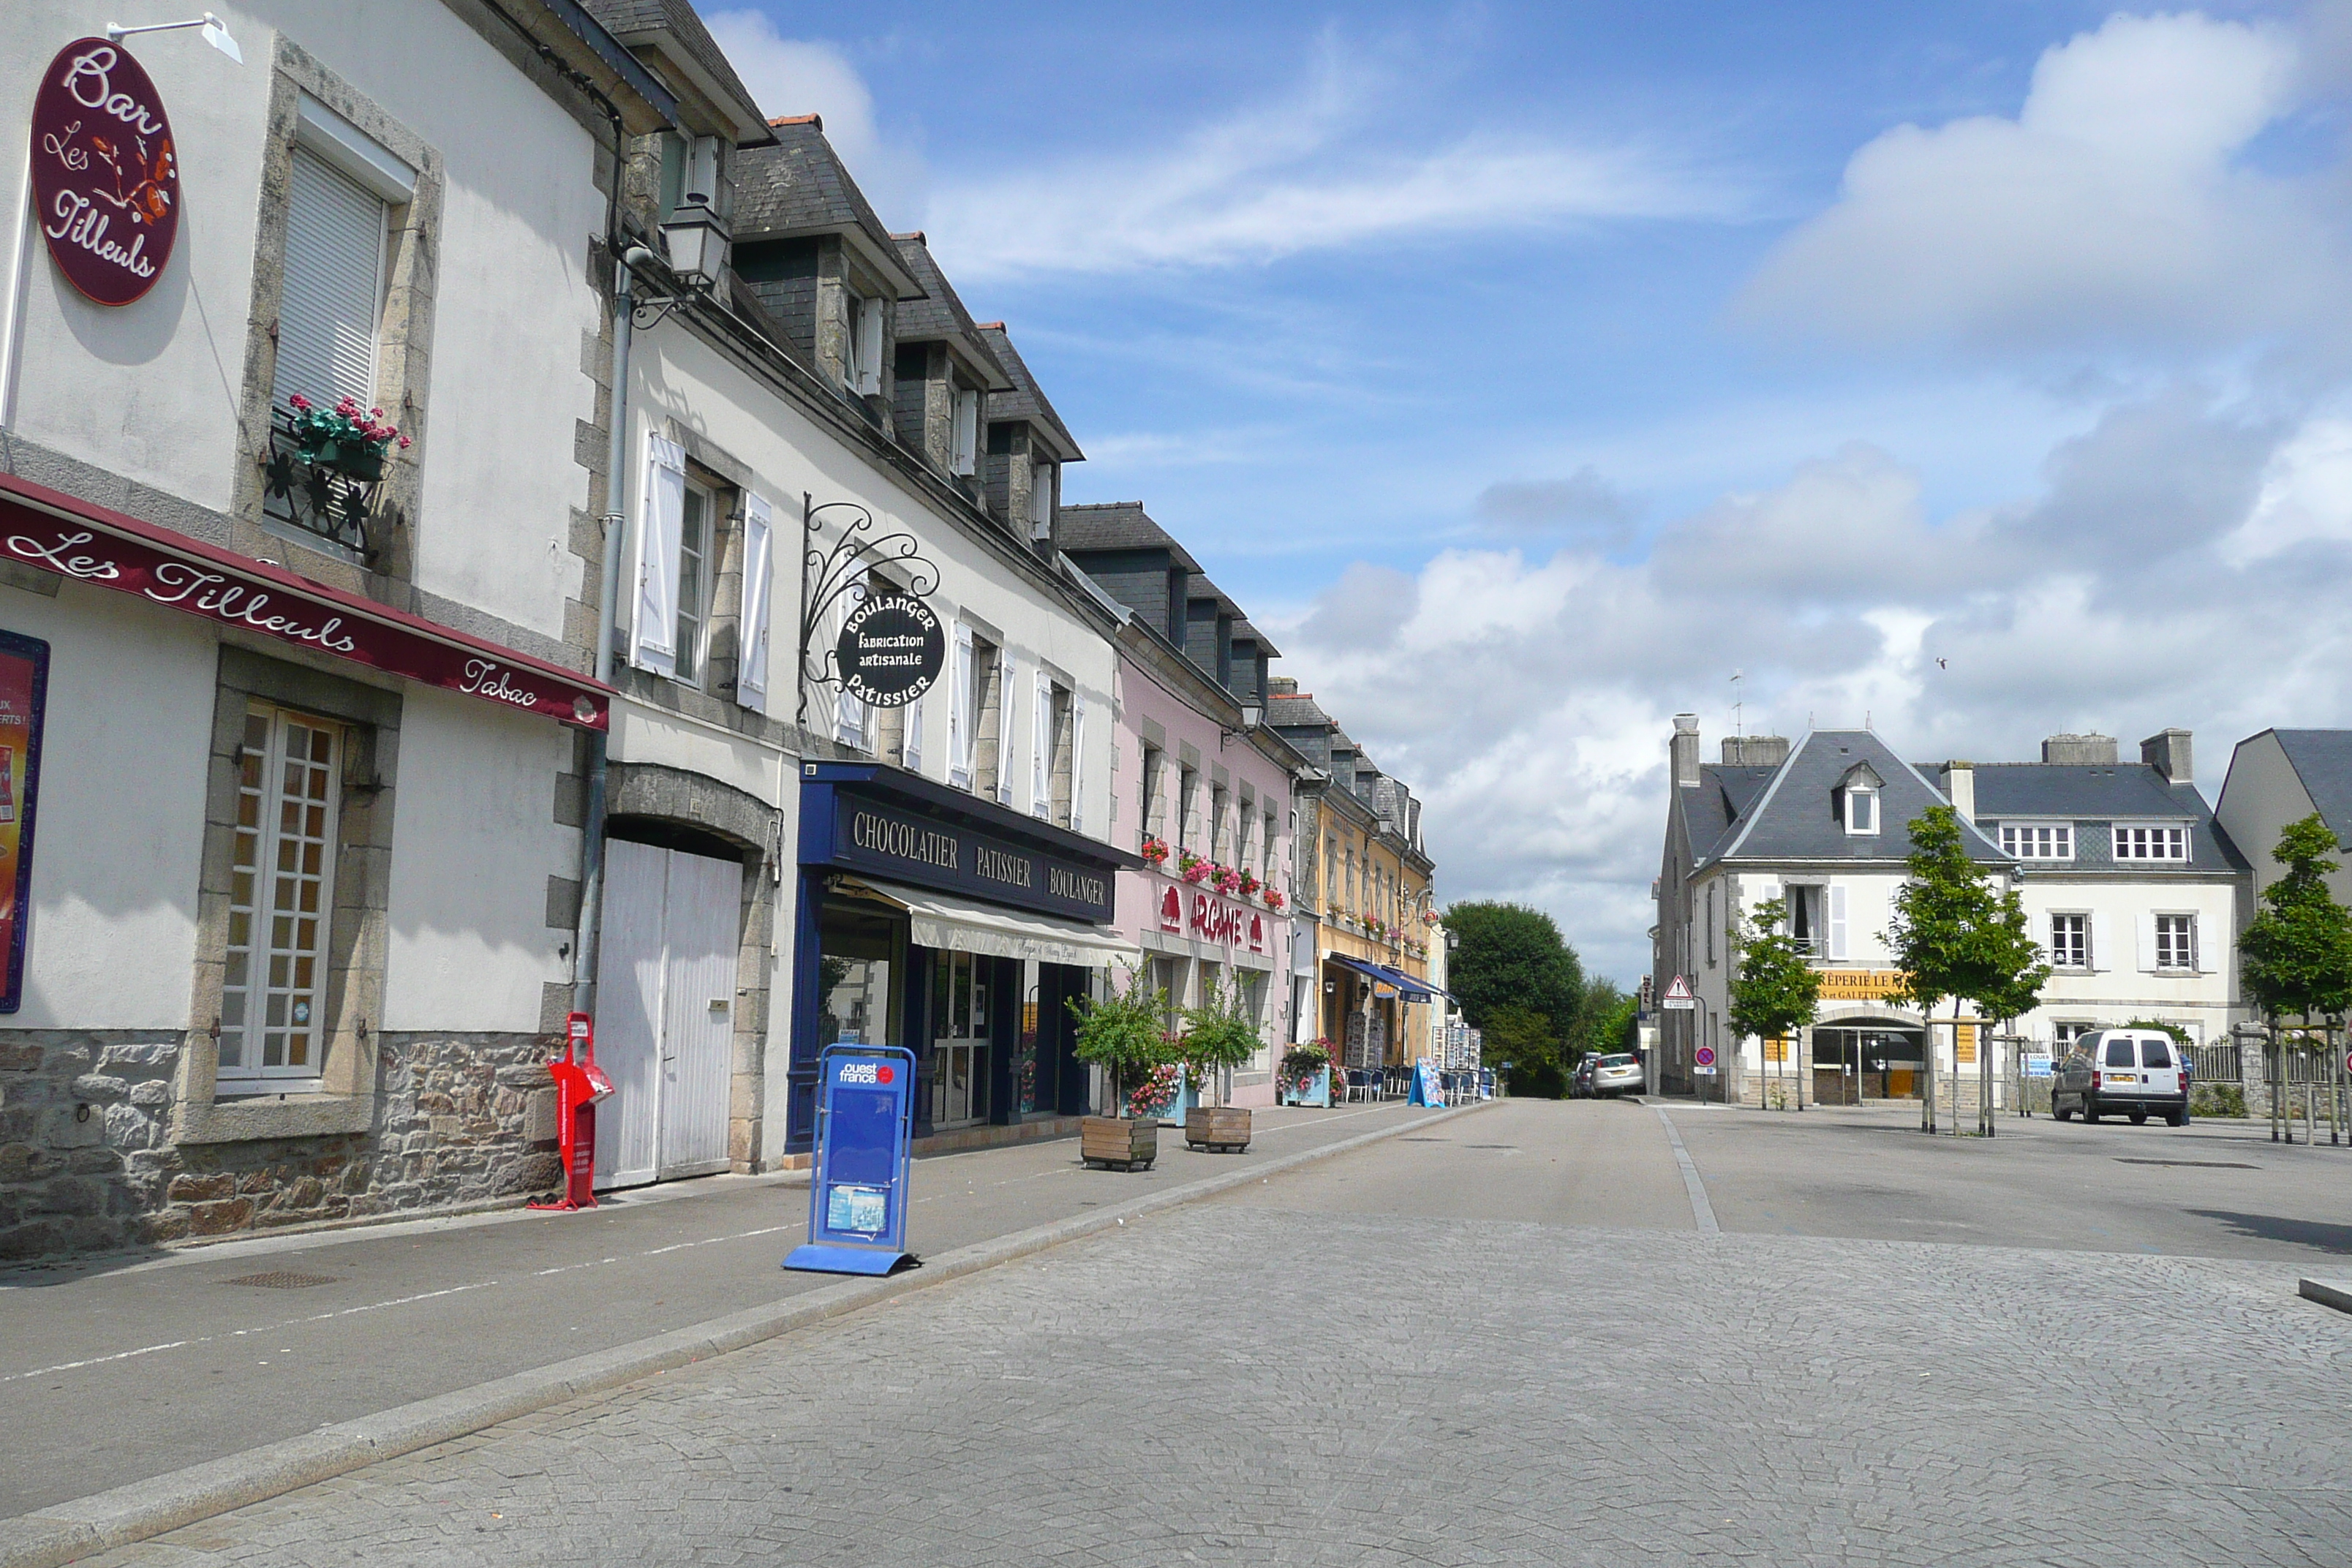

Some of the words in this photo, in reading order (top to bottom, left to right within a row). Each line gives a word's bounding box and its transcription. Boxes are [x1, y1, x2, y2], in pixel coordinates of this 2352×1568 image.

[63, 47, 162, 135] Bar
[44, 120, 88, 170] Les
[46, 189, 155, 277] Tilleuls
[7, 532, 119, 578] Les
[143, 563, 355, 652] Tilleuls
[459, 659, 537, 706] Tabac
[854, 811, 957, 869] CHOCOLATIER
[977, 846, 1030, 888] PATISSIER
[1049, 867, 1104, 905] BOULANGER
[1190, 890, 1243, 950] ARGANE
[1817, 972, 1871, 986] RÊPERIE
[1874, 976, 1888, 987] LE
[840, 1070, 876, 1084] france
[844, 1063, 877, 1074] ouest
